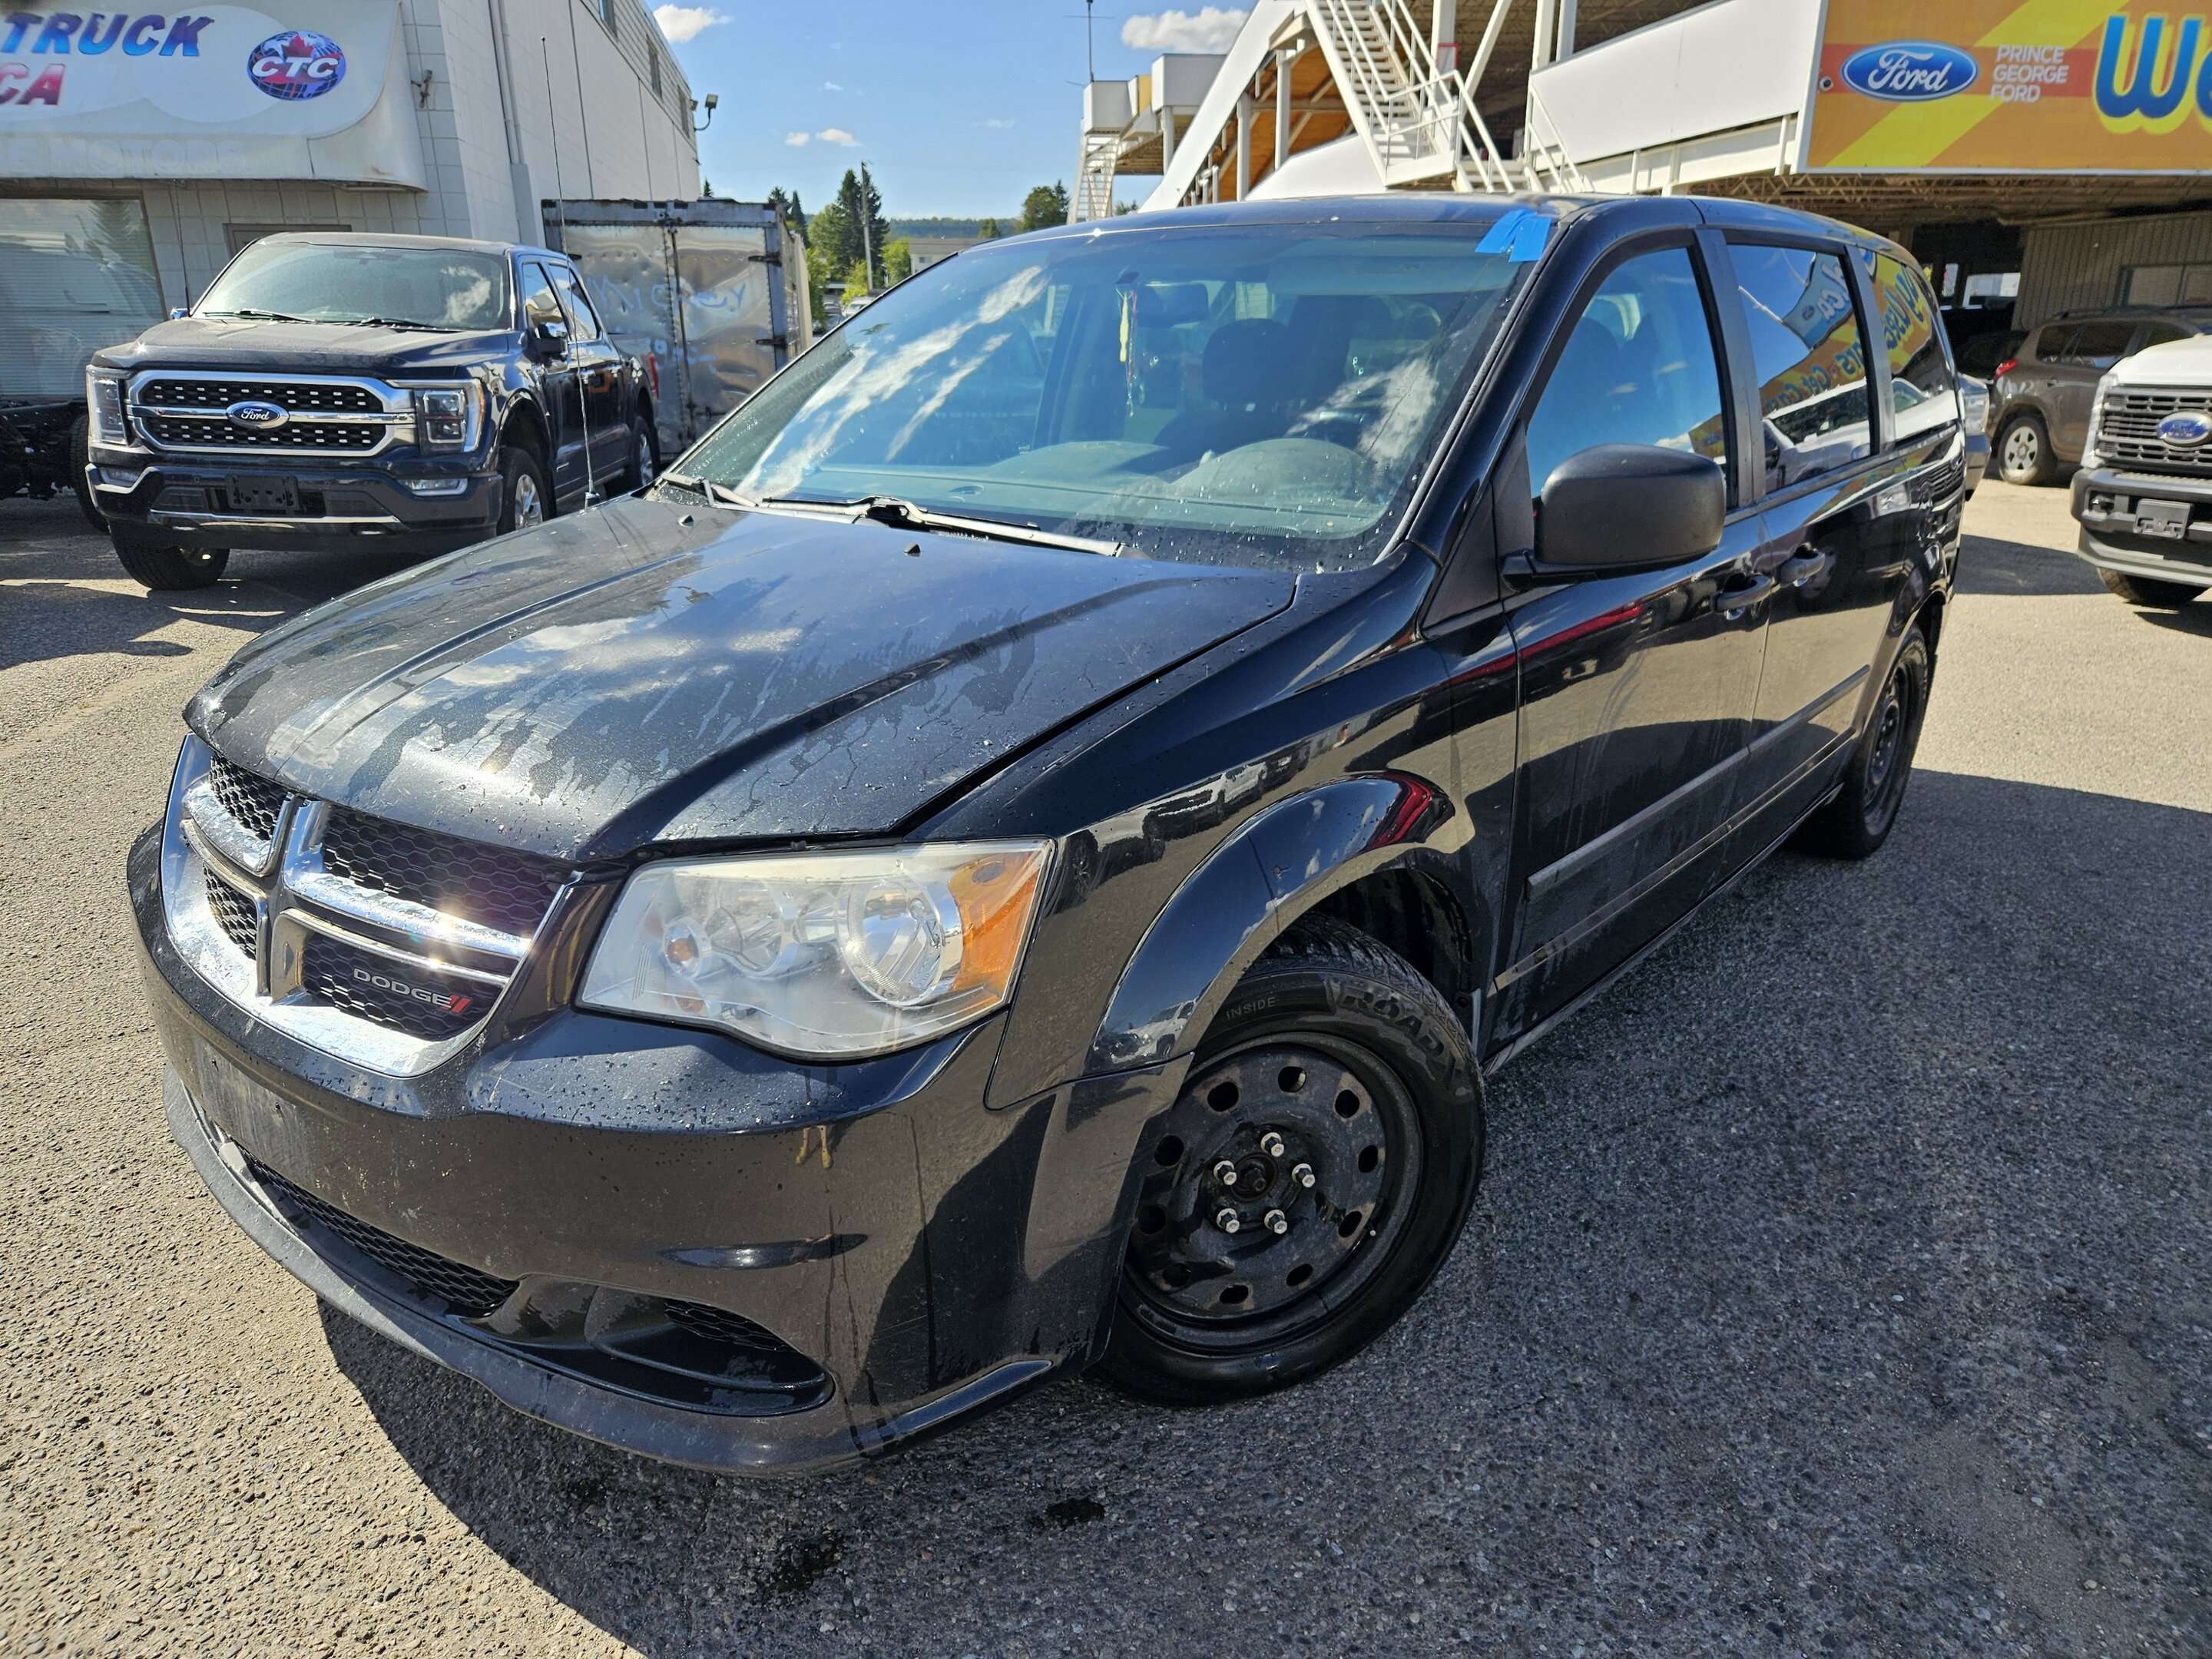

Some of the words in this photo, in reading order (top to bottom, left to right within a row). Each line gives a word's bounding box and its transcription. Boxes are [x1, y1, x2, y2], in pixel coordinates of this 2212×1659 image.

[1, 12, 215, 56] TRUCK
[1996, 45, 2065, 64] PRINCE
[252, 56, 339, 78] CTC
[1868, 48, 1953, 92] Ford
[1992, 64, 2070, 84] GEORGE
[2094, 15, 2212, 120] W
[1990, 84, 2041, 103] FORD
[240, 408, 270, 421] Ford
[353, 968, 452, 1008] DODGE
[1225, 996, 1277, 1021] INSIDE
